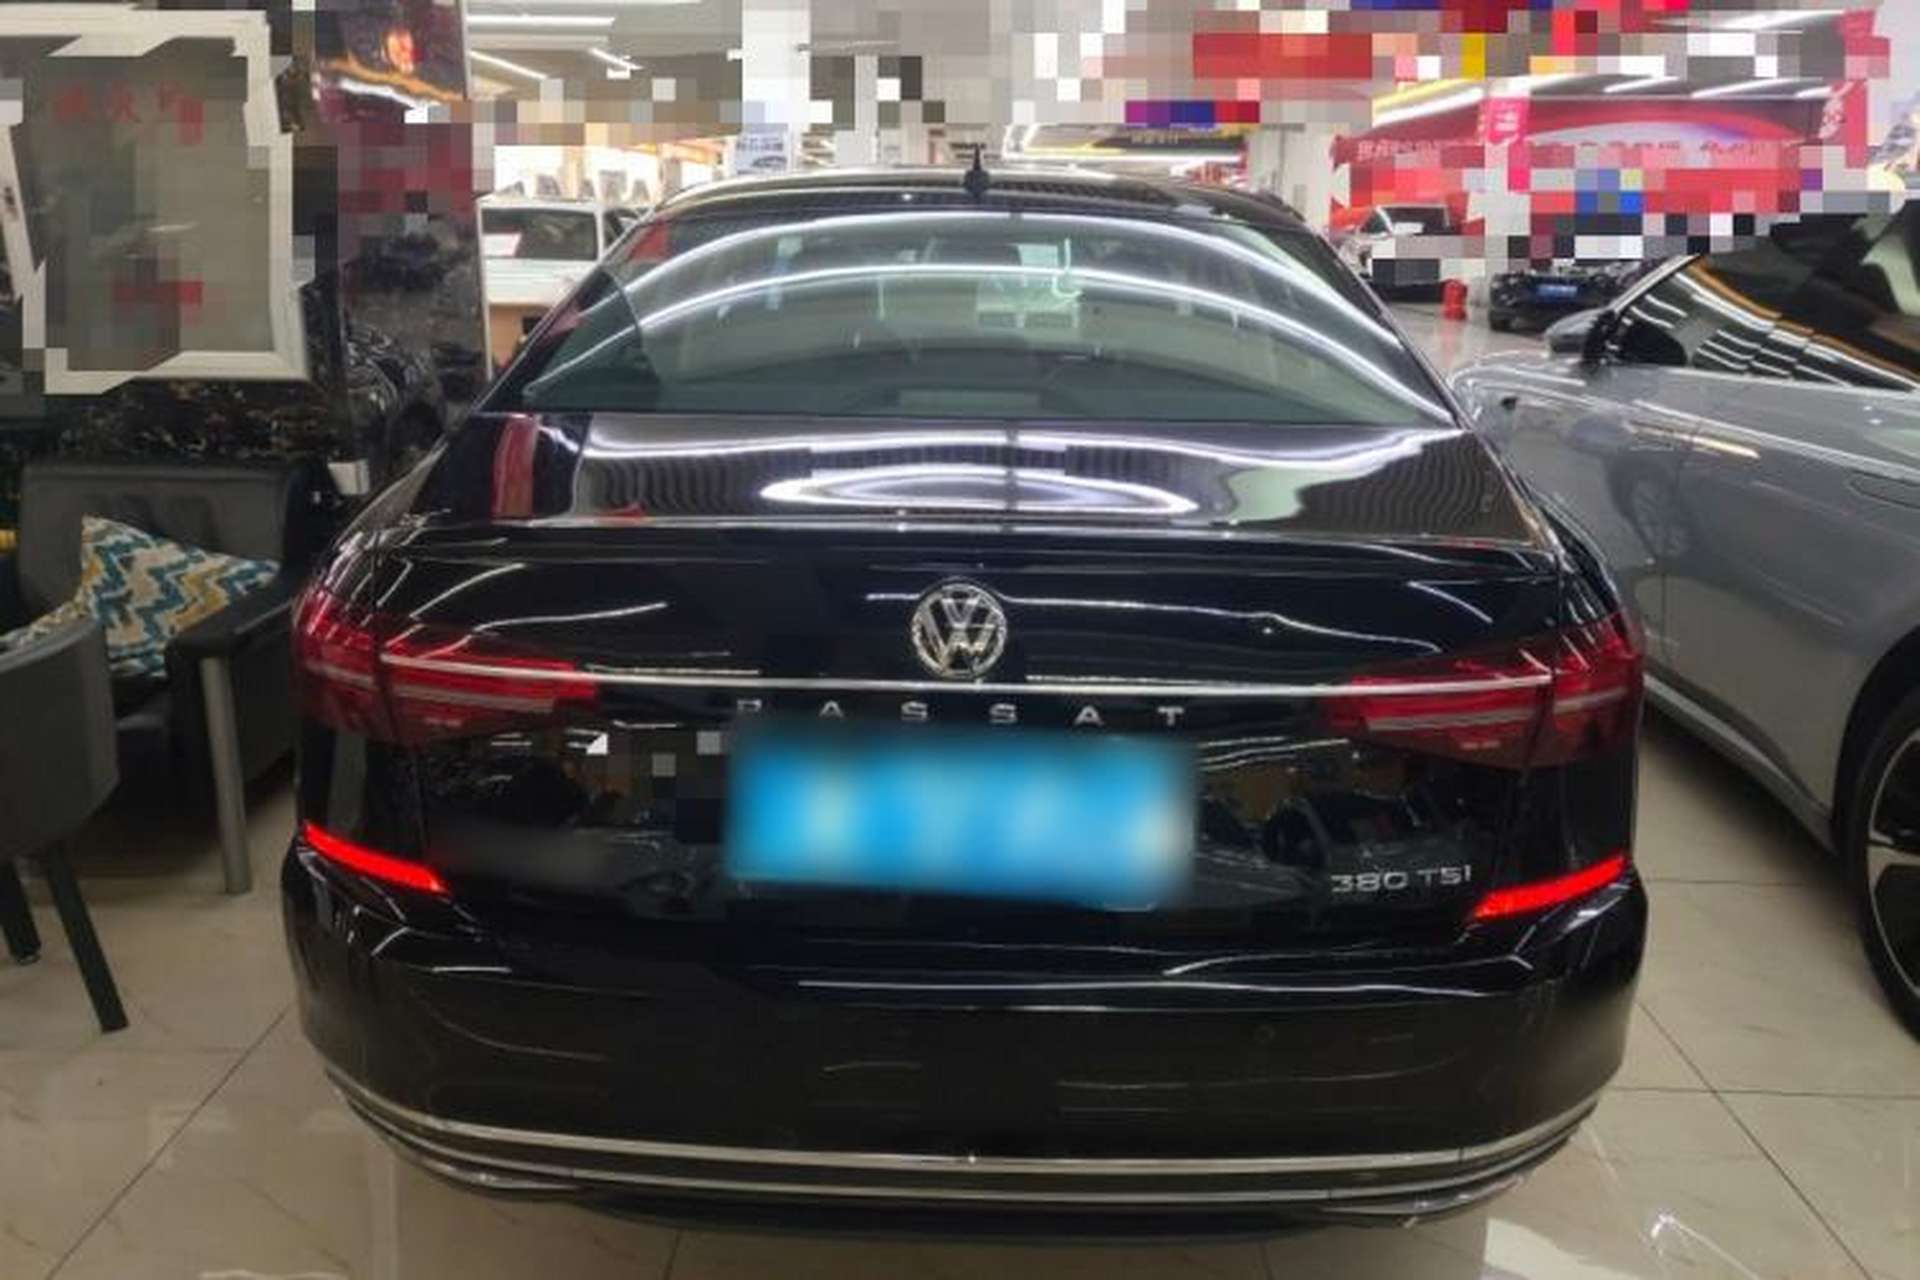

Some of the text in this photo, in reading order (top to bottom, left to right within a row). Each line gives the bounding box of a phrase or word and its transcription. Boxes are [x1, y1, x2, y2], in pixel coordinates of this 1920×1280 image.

[736, 699, 1185, 726] PASSAT
[1330, 864, 1472, 892] 380 TSI
